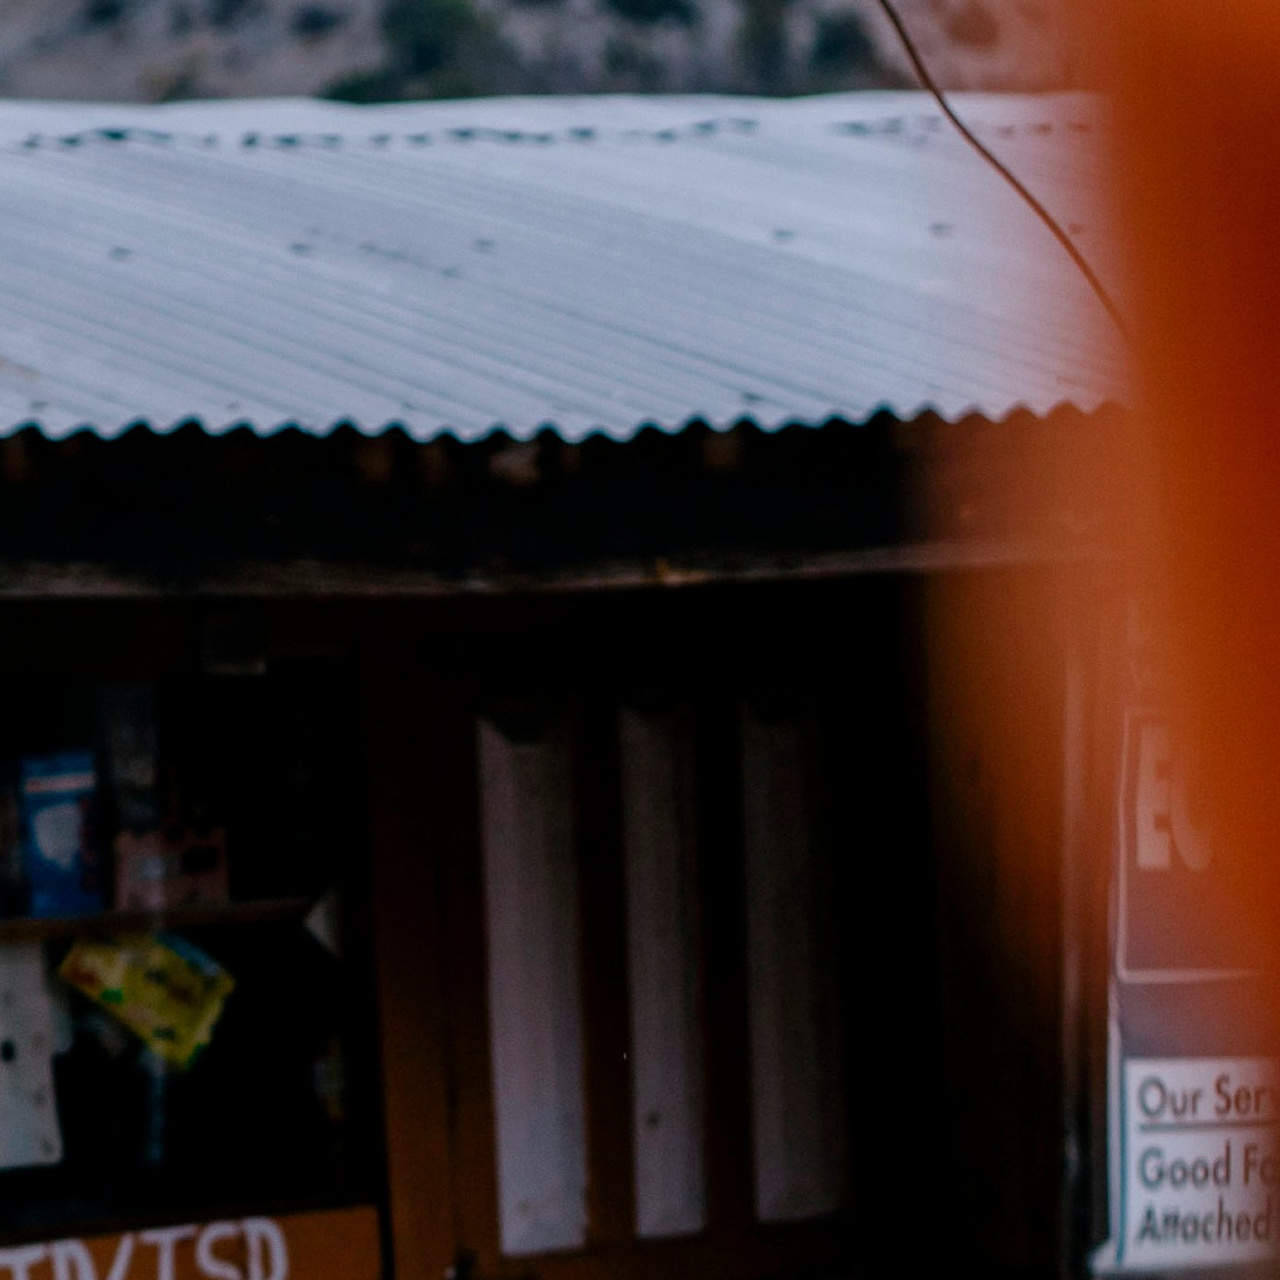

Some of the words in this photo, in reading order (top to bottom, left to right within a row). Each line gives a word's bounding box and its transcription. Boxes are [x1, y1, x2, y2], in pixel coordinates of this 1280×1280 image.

[1138, 1076, 1202, 1118] Our
[1214, 1074, 1280, 1115] Ser
[1138, 1139, 1230, 1188] Good
[1137, 1196, 1274, 1244] Attached
